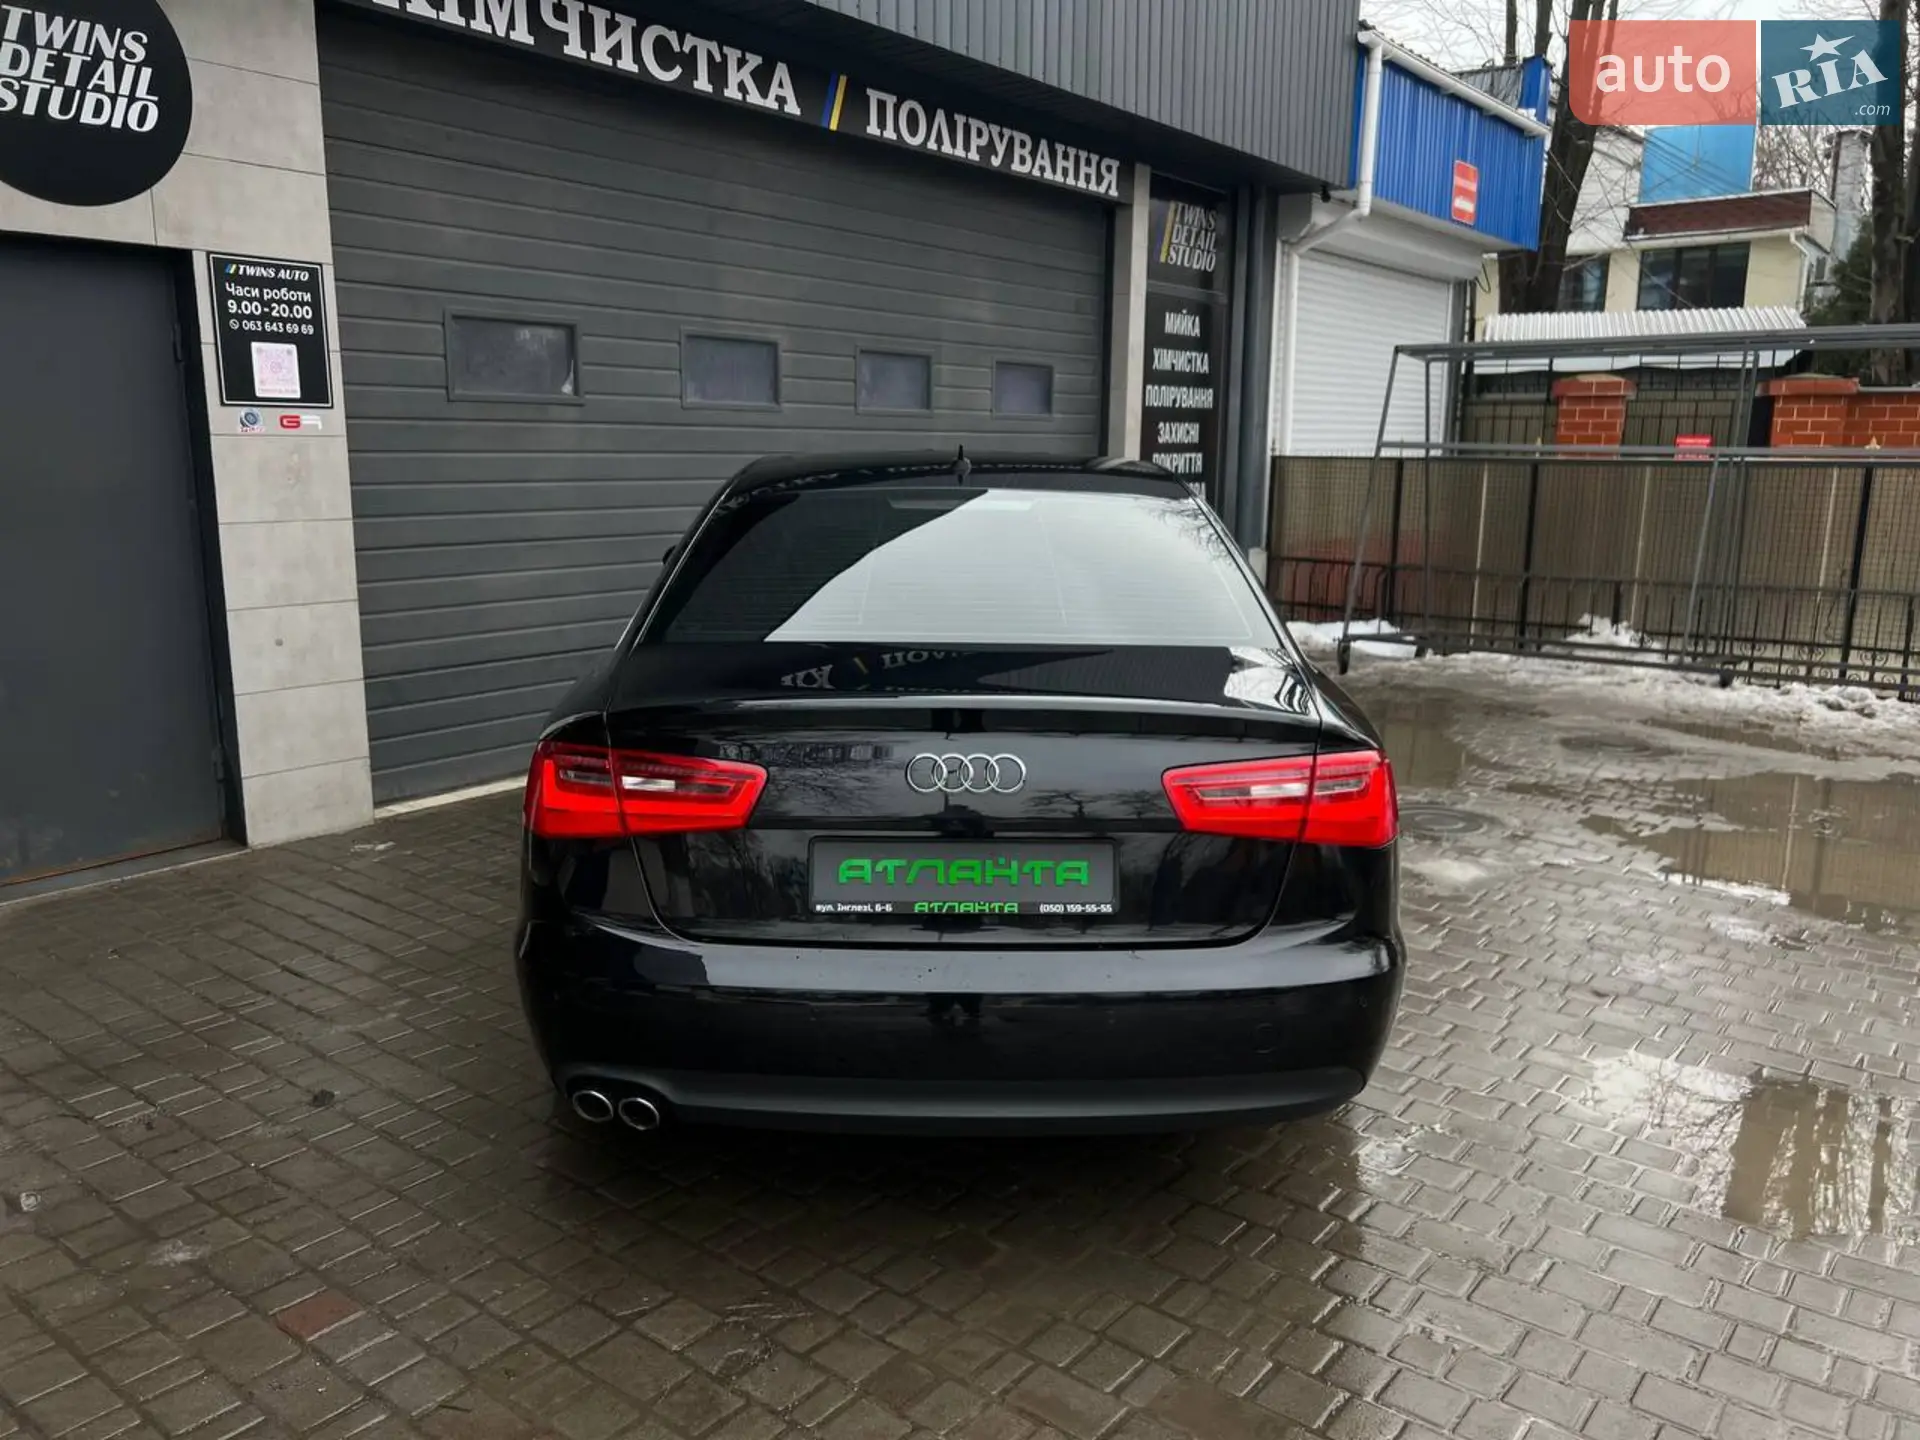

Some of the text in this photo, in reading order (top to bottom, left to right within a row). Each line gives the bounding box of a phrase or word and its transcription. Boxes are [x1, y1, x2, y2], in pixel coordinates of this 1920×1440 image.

[1, 4, 148, 63] TWINS
[0, 41, 159, 101] DETAIL
[0, 77, 159, 133] STUDIO
[372, 0, 1120, 197] МЧИСТКА ПОЛІРУВАННЯ
[1175, 201, 1217, 230] TWINS
[1171, 223, 1217, 253] DETAIL
[1167, 243, 1216, 272] STUDIO
[238, 264, 310, 281] TWINS AUTO
[225, 281, 312, 303] Часи роботи
[242, 320, 315, 336] 063 643 69 69
[1164, 308, 1201, 338] МИЙКА
[1152, 347, 1210, 375] ХІМЧИСТКА
[1145, 384, 1214, 410] ПОЛІРУВАННЯ
[1157, 421, 1200, 445] ЗАХИСНІ
[1039, 902, 1065, 914] (050)
